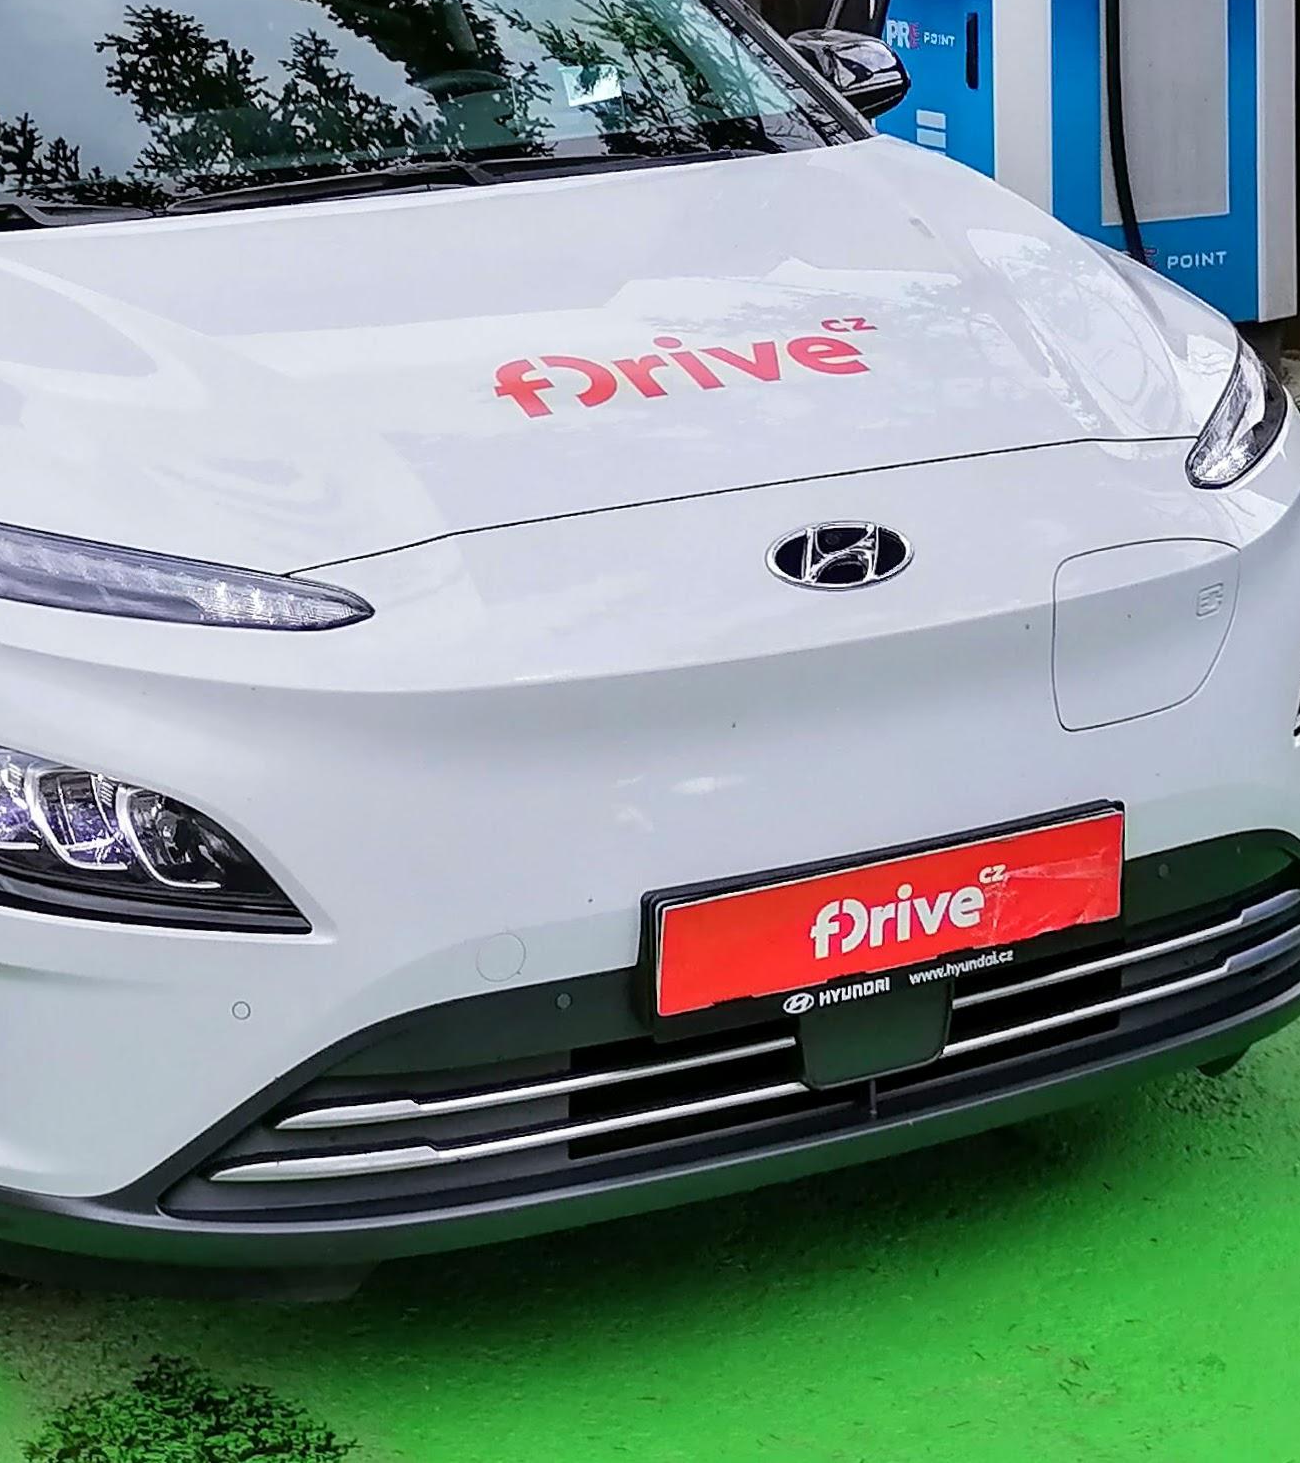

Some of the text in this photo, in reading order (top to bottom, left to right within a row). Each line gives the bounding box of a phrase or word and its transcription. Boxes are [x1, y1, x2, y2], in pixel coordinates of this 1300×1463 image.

[923, 31, 956, 48] POINT
[1167, 250, 1228, 270] POINT
[818, 949, 1015, 1008] HYUNDAI www.hyundai.cz
